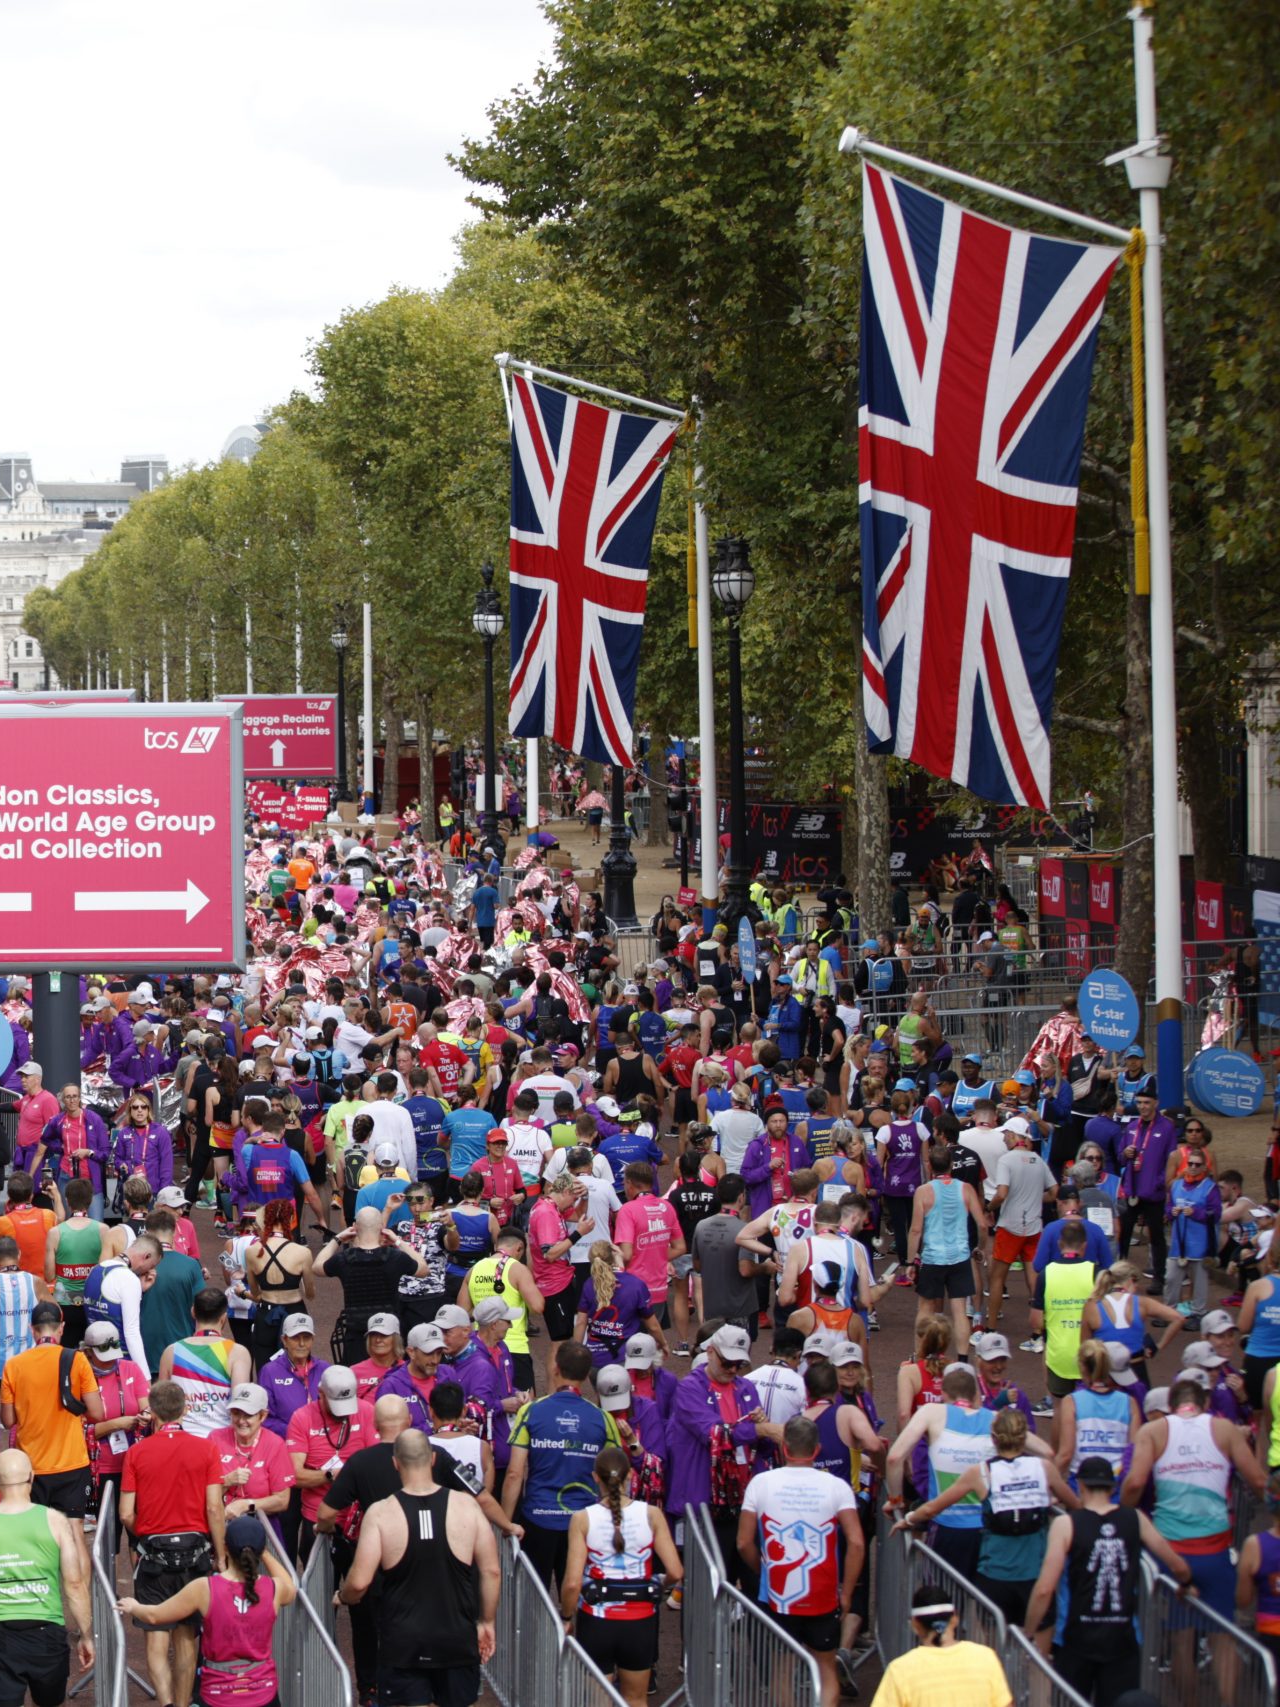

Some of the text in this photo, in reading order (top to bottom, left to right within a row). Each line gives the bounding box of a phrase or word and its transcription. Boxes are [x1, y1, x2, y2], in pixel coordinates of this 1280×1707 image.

[283, 714, 324, 724] Reclaim
[297, 727, 330, 736] Lorries
[144, 727, 178, 750] tcs
[46, 784, 160, 808] Classics,
[75, 812, 128, 838] Age
[135, 811, 216, 835] Group
[802, 832, 830, 840] balance
[31, 838, 163, 859] Collection
[793, 852, 828, 878] tcs
[1094, 1004, 1124, 1020] 6-star
[1091, 1020, 1130, 1038] finisher
[513, 1149, 537, 1157] JAMIE
[681, 1192, 714, 1202] STAFF
[96, 1302, 108, 1310] run
[1080, 1430, 1115, 1443] JDRF
[531, 1438, 599, 1452] United run
[826, 1458, 843, 1466] lives
